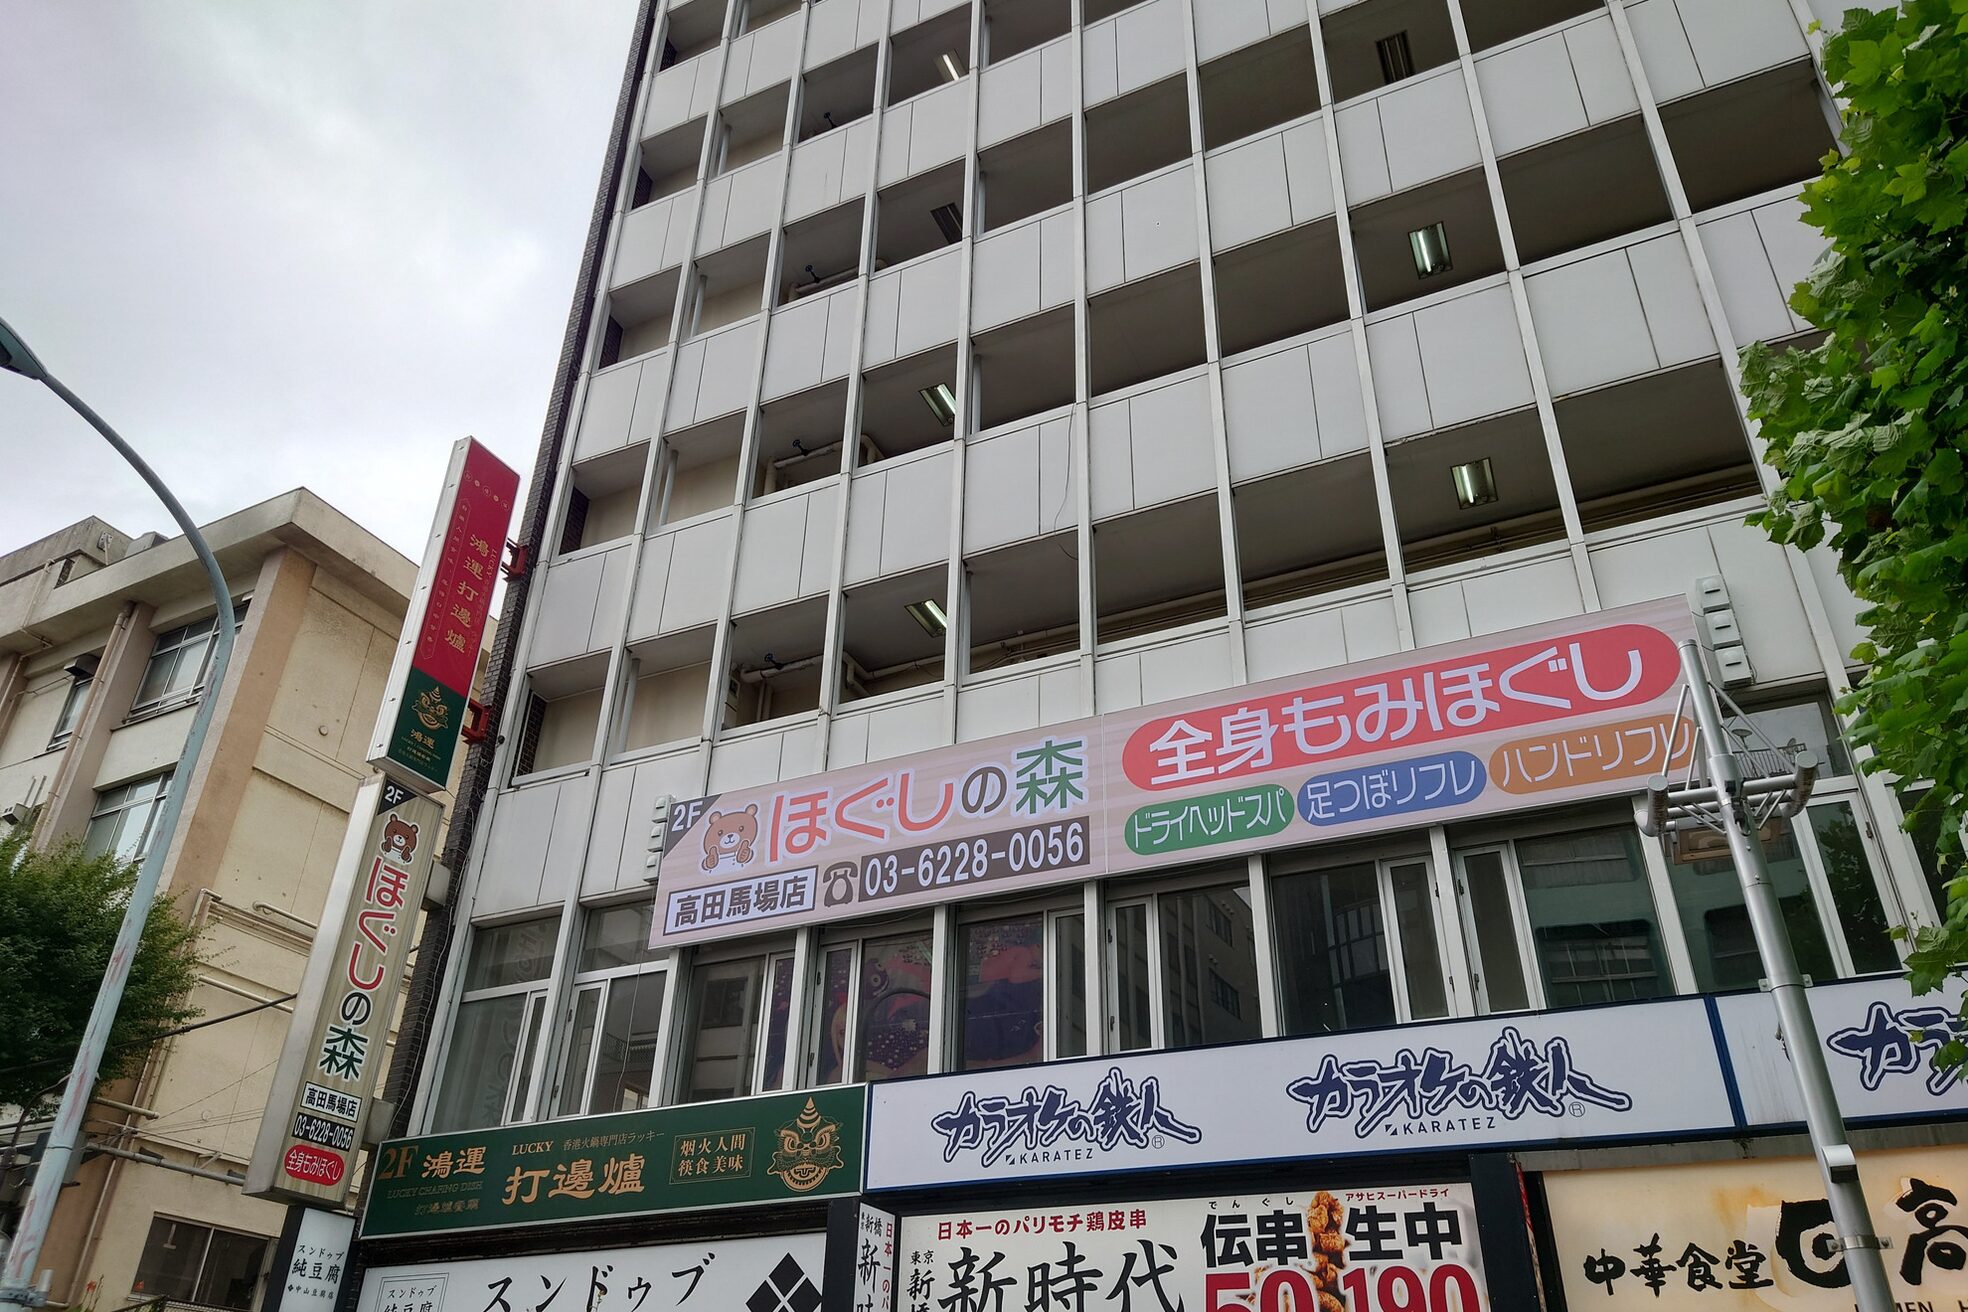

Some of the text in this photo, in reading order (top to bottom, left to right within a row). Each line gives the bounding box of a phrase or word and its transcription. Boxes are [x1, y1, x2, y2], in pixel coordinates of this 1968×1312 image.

[1149, 643, 1643, 786] 全身もみほぐし
[384, 786, 403, 804] 2F
[769, 740, 1083, 862] ほぐしの森
[1133, 722, 1690, 848] ドライヘッドスパ 足つぼリフレ ハンドリフレ
[672, 801, 703, 832] 2F
[674, 823, 1084, 928] 高田馬場店 03-6228-0056
[321, 857, 407, 1080] ほぐしの森
[305, 1087, 358, 1118] 高田馬場店
[294, 1114, 354, 1150] 03-6228-0056
[1403, 1116, 1496, 1136] KARATEZ
[378, 1145, 419, 1180] 2F
[512, 1140, 554, 1156] LUCKY
[1020, 1148, 1093, 1165] KARATEZ
[286, 1149, 342, 1181] 全身もみほぐし
[1209, 1197, 1294, 1210] でんぐし
[1345, 1188, 1450, 1202] アサヒスーパードライ
[937, 1208, 1147, 1241] 日本一のパリモチ鶏皮串
[1200, 1209, 1308, 1268] 伝串
[1345, 1202, 1462, 1260] 生中
[291, 1258, 341, 1285] 純豆腐
[911, 1250, 934, 1265] 東京
[1584, 1234, 1774, 1298] 中華食堂
[937, 1239, 1185, 1312] 新時代
